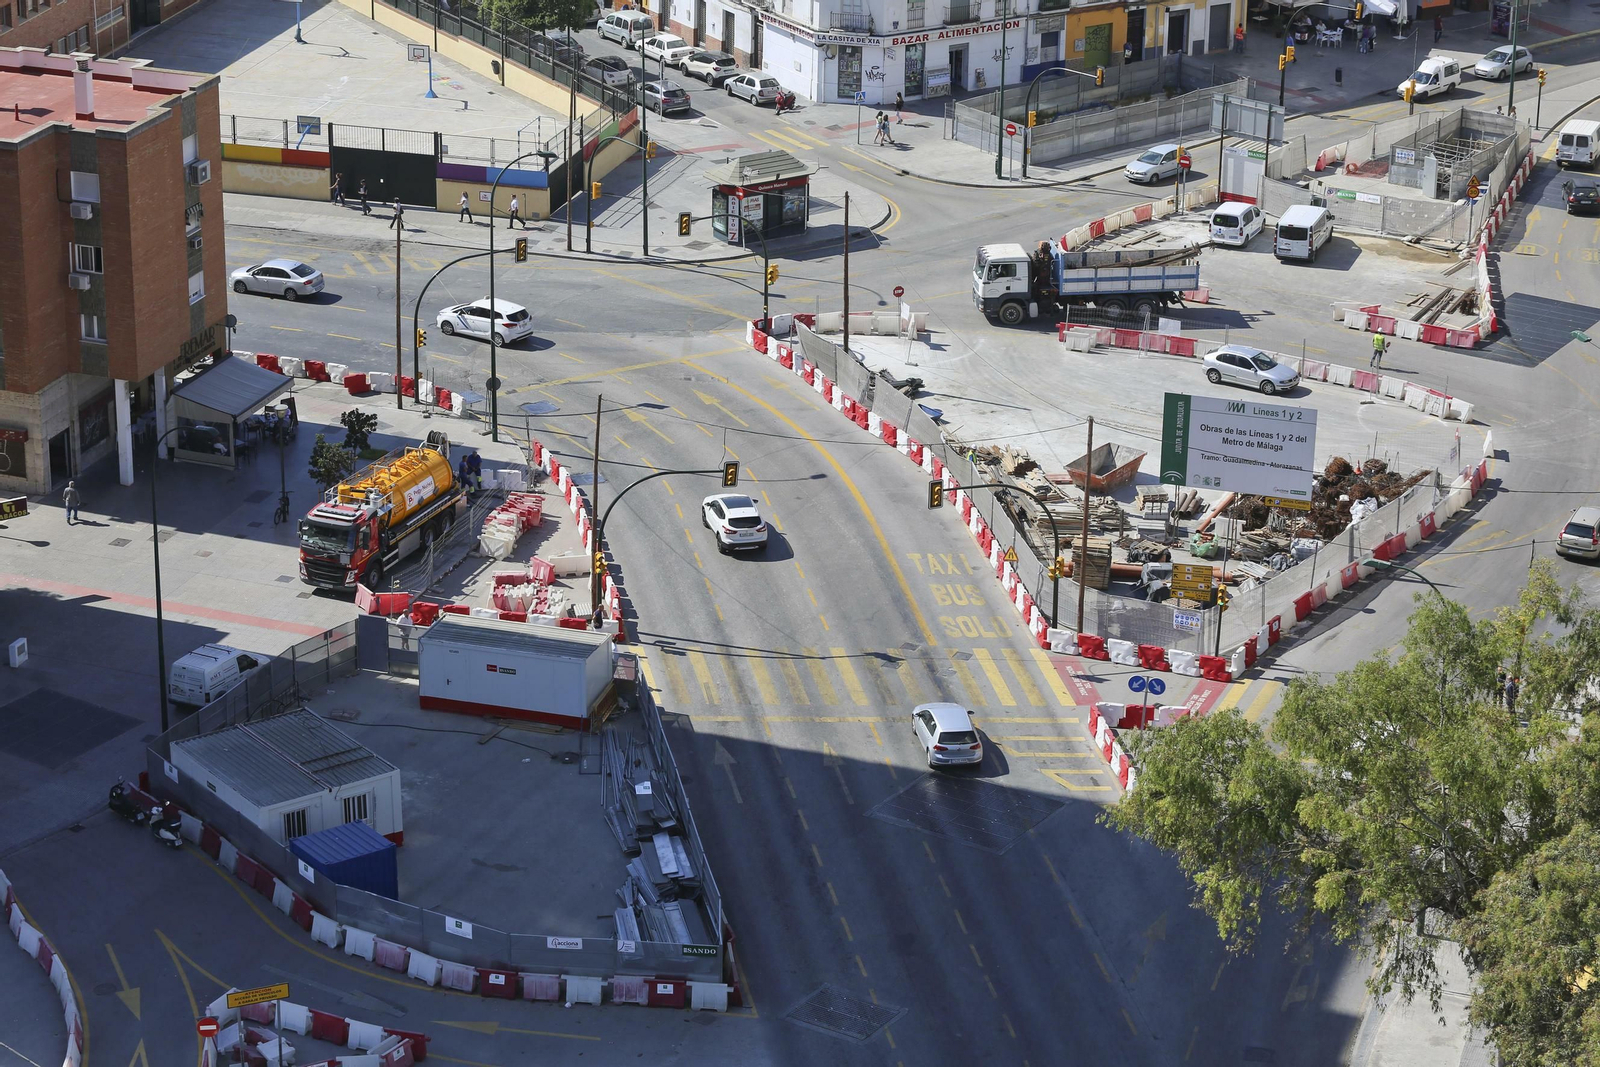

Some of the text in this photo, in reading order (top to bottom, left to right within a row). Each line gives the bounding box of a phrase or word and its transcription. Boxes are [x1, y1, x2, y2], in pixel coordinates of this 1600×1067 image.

[828, 35, 855, 43] CASITA
[892, 20, 1020, 46] BAZAR ALIMENTACION
[1253, 407, 1280, 418] Líneas
[1288, 411, 1295, 421] y
[1297, 411, 1303, 420] 2
[1200, 423, 1223, 434] Obras
[1224, 425, 1234, 435] de
[1235, 427, 1247, 436] las
[1248, 429, 1274, 440] Líneas
[1282, 433, 1288, 442] y
[1288, 433, 1294, 441] 2
[1295, 435, 1307, 443] del
[1221, 437, 1284, 452] Metro de Málaga
[1201, 453, 1222, 462] Tramo:
[906, 553, 974, 576] TAXI
[929, 584, 987, 607] BUS
[687, 947, 717, 955] SANDO
